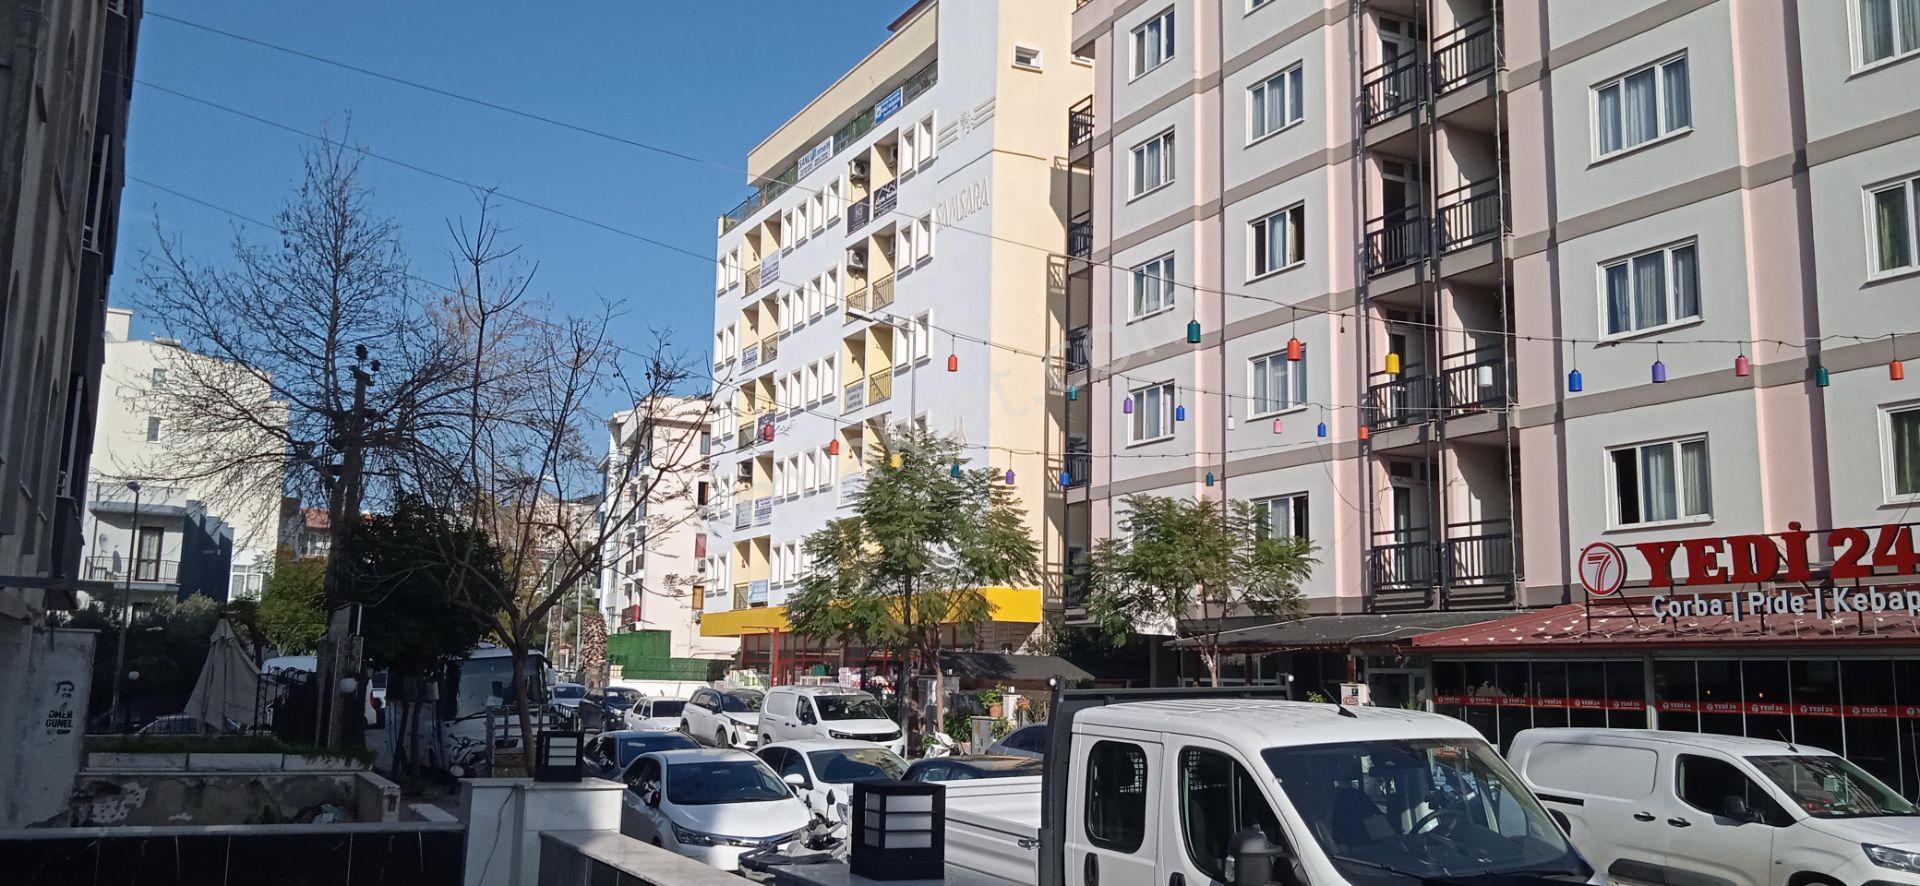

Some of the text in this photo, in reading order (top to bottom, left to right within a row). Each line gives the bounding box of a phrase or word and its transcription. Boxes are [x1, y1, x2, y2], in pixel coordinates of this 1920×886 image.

[1635, 521, 1920, 587] YEDİ 24
[1652, 593, 1723, 623] Çorba
[1833, 586, 1920, 617] Kebap
